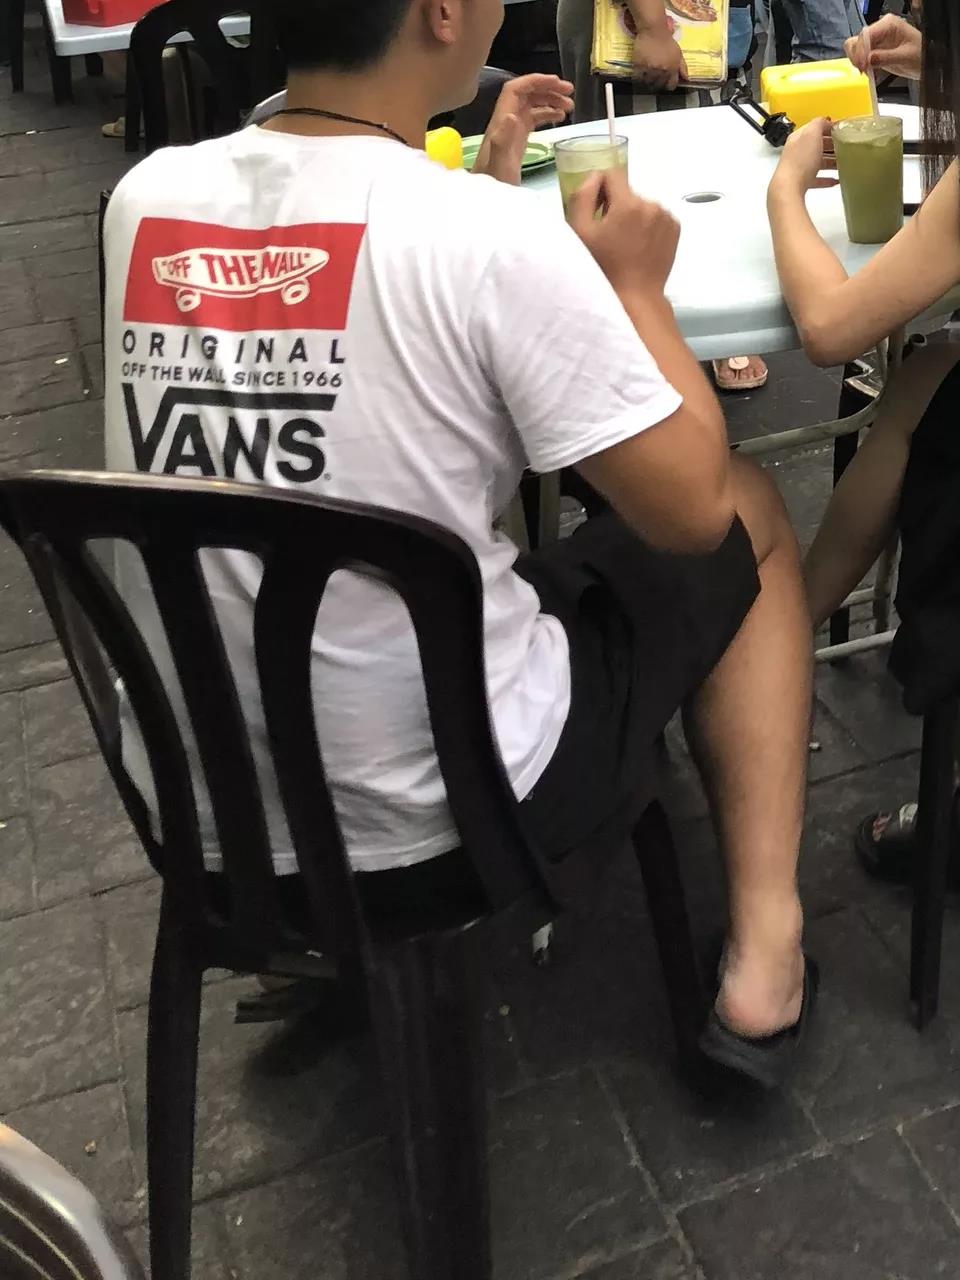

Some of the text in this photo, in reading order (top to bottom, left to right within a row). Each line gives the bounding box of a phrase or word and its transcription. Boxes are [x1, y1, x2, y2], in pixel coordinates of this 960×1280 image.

[199, 253, 260, 286] THE
[122, 329, 345, 365] ORIGINAL
[122, 362, 342, 388] OFF THE WALL SINCE 1966
[121, 382, 336, 483] VANS
